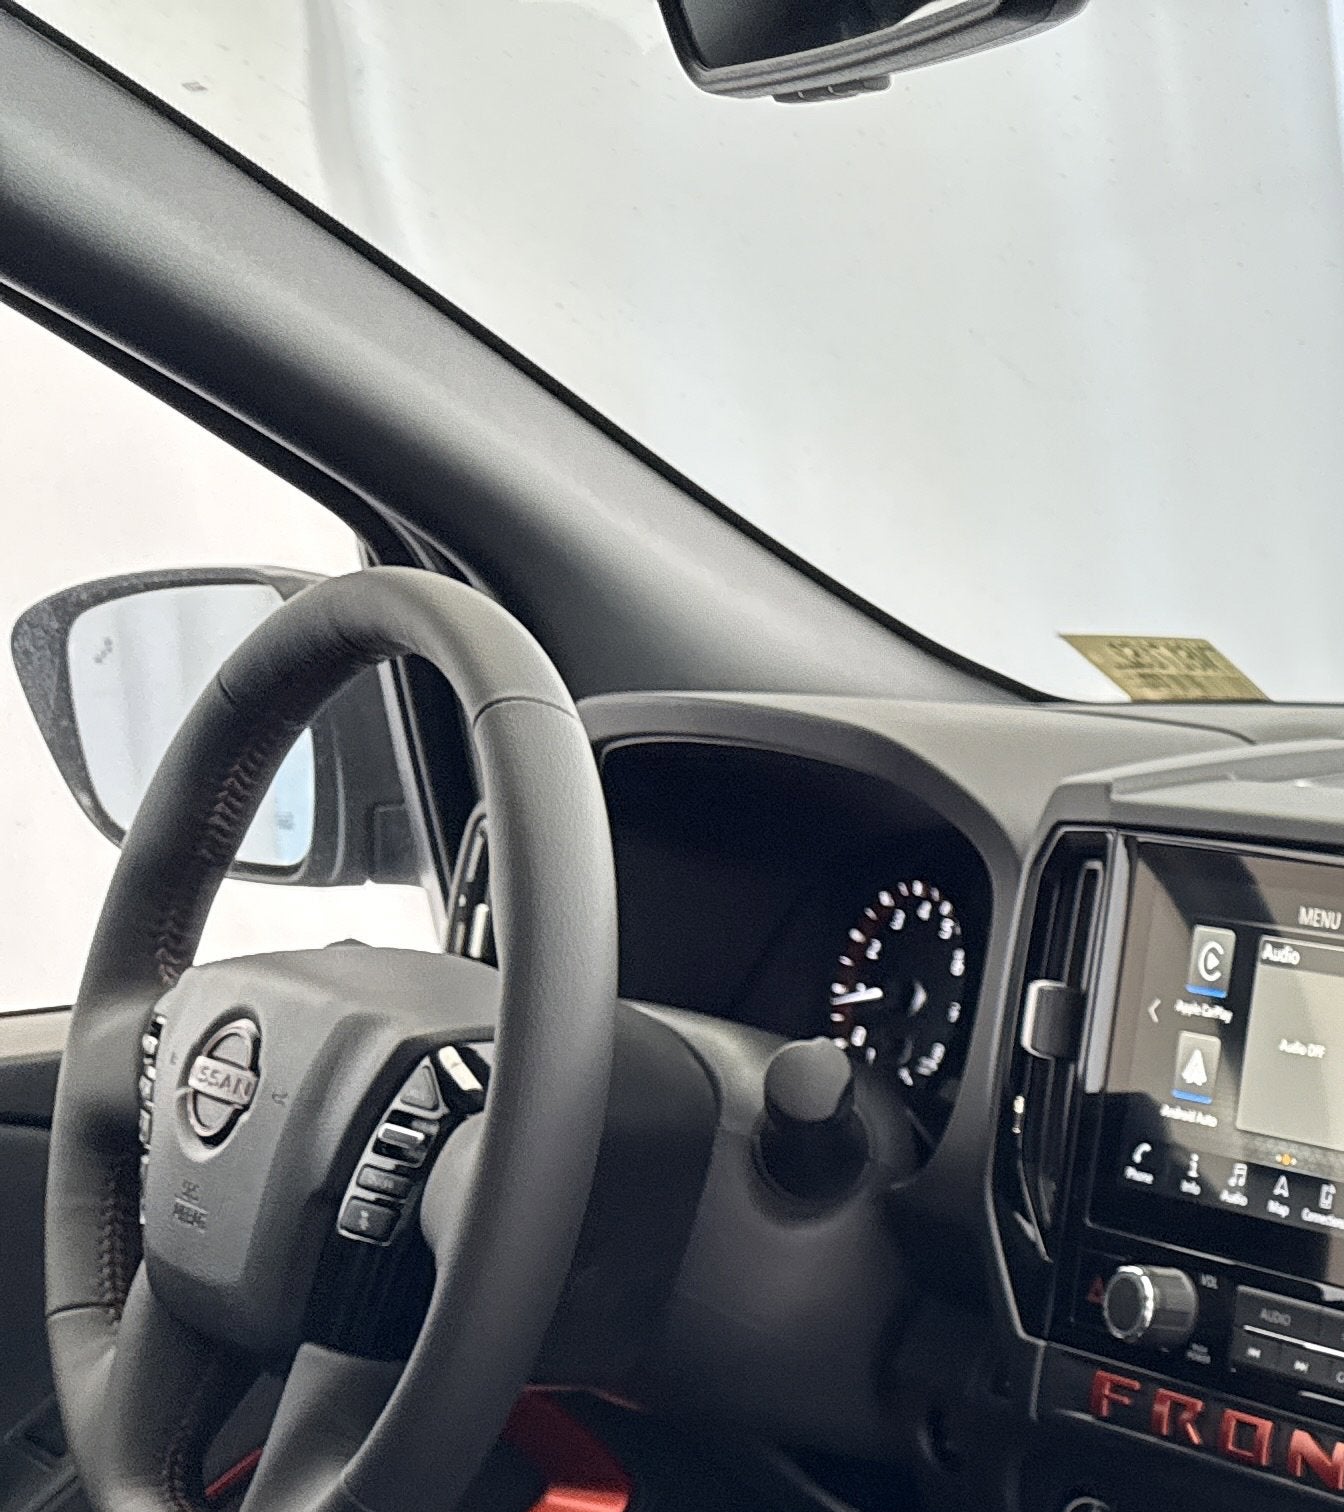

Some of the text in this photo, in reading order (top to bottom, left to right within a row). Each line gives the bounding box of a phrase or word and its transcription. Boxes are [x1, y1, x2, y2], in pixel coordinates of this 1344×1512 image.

[1298, 906, 1342, 929] MENU
[1261, 943, 1301, 965] Audio
[1279, 1038, 1327, 1059] Audio OFF
[1260, 1308, 1291, 1327] AUDIO
